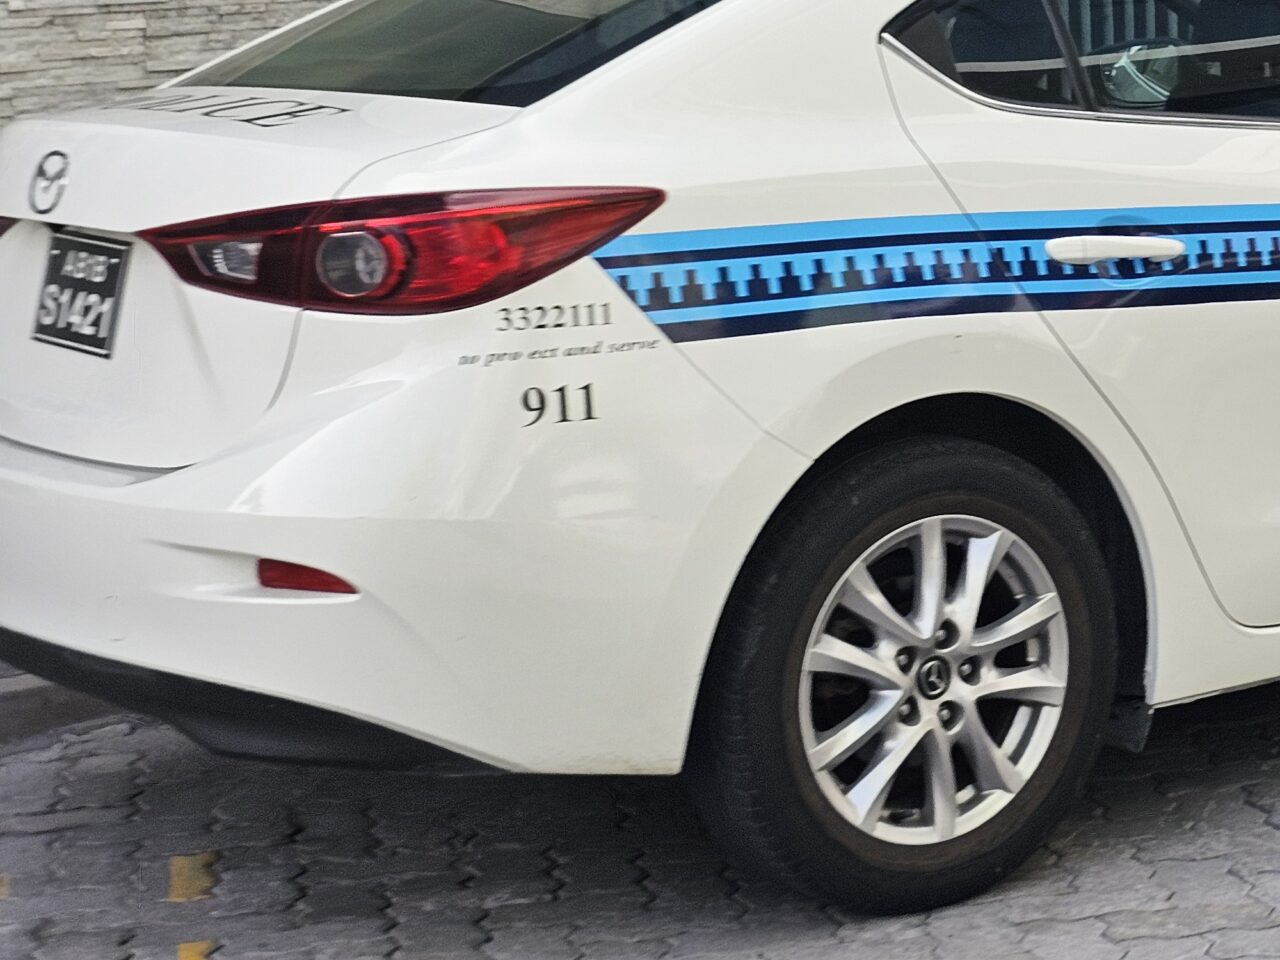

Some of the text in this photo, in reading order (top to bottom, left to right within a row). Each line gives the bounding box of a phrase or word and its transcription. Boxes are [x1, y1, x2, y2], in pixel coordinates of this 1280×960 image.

[40, 284, 115, 338] S1421
[496, 302, 615, 331] 3322111
[520, 382, 600, 428] 911
